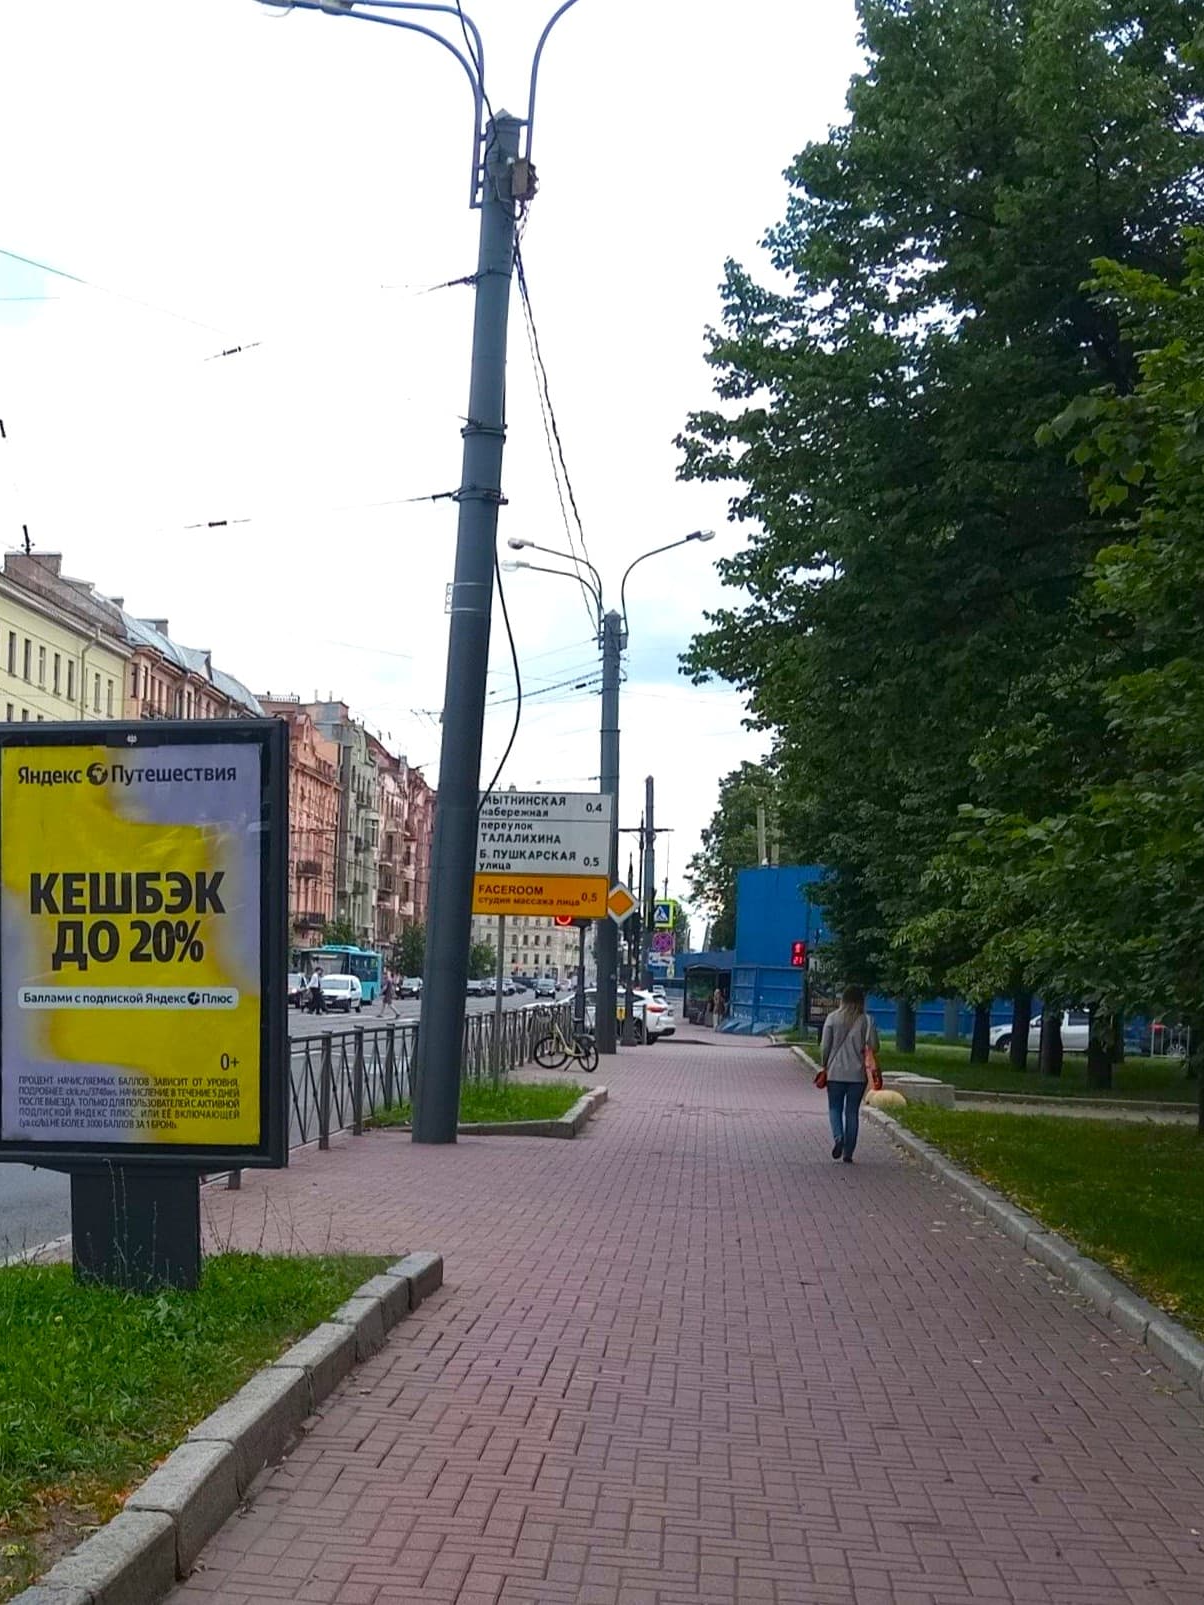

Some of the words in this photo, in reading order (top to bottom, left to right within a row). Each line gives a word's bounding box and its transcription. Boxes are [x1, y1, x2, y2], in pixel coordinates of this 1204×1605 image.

[18, 766, 82, 786] Яндекс
[111, 764, 237, 784] Путешествия
[481, 806, 549, 818] набережная
[586, 802, 602, 813] 0,4
[481, 822, 533, 832] переулок
[481, 833, 561, 844] ТАЛАЛИХИНА
[493, 850, 576, 861] ПУШКАРСКАЯ
[479, 862, 511, 871] улица
[583, 857, 600, 867] 0,5
[30, 871, 226, 914] КЕШБЭК
[478, 884, 544, 895] FACEROOM
[478, 896, 511, 906] студия
[513, 897, 554, 906] массажа
[556, 898, 581, 907] лица
[581, 892, 598, 903] 0,5
[51, 920, 121, 971] ДО
[129, 920, 204, 964] 20%
[23, 992, 73, 1003] Баллами
[74, 995, 81, 1003] с
[82, 992, 143, 1005] подпиской
[145, 993, 186, 1005] Яндекс
[202, 993, 233, 1004] Плюс
[220, 1052, 240, 1071] 0+
[18, 1075, 53, 1085] ПРОЦЕНТ
[118, 1077, 150, 1086] БАЛЛОВ
[153, 1077, 188, 1087] ЗАВИСИТ
[192, 1078, 203, 1087] ОТ
[119, 1088, 170, 1097] НАЧИСЛЕНИЕ
[177, 1088, 211, 1097] ТЕЧЕНИЕ
[218, 1087, 240, 1098] ДНЕЙ
[18, 1097, 44, 1106] ПОСЛЕ
[126, 1098, 190, 1108] ПОЛЬЗОВАТЕЛЕЙ
[197, 1098, 240, 1109] АКТИВНОЙ
[18, 1107, 72, 1117] ПОДПИСКОЙ
[74, 1108, 108, 1118] ЯНДЕКС
[140, 1109, 159, 1118] ИЛИ
